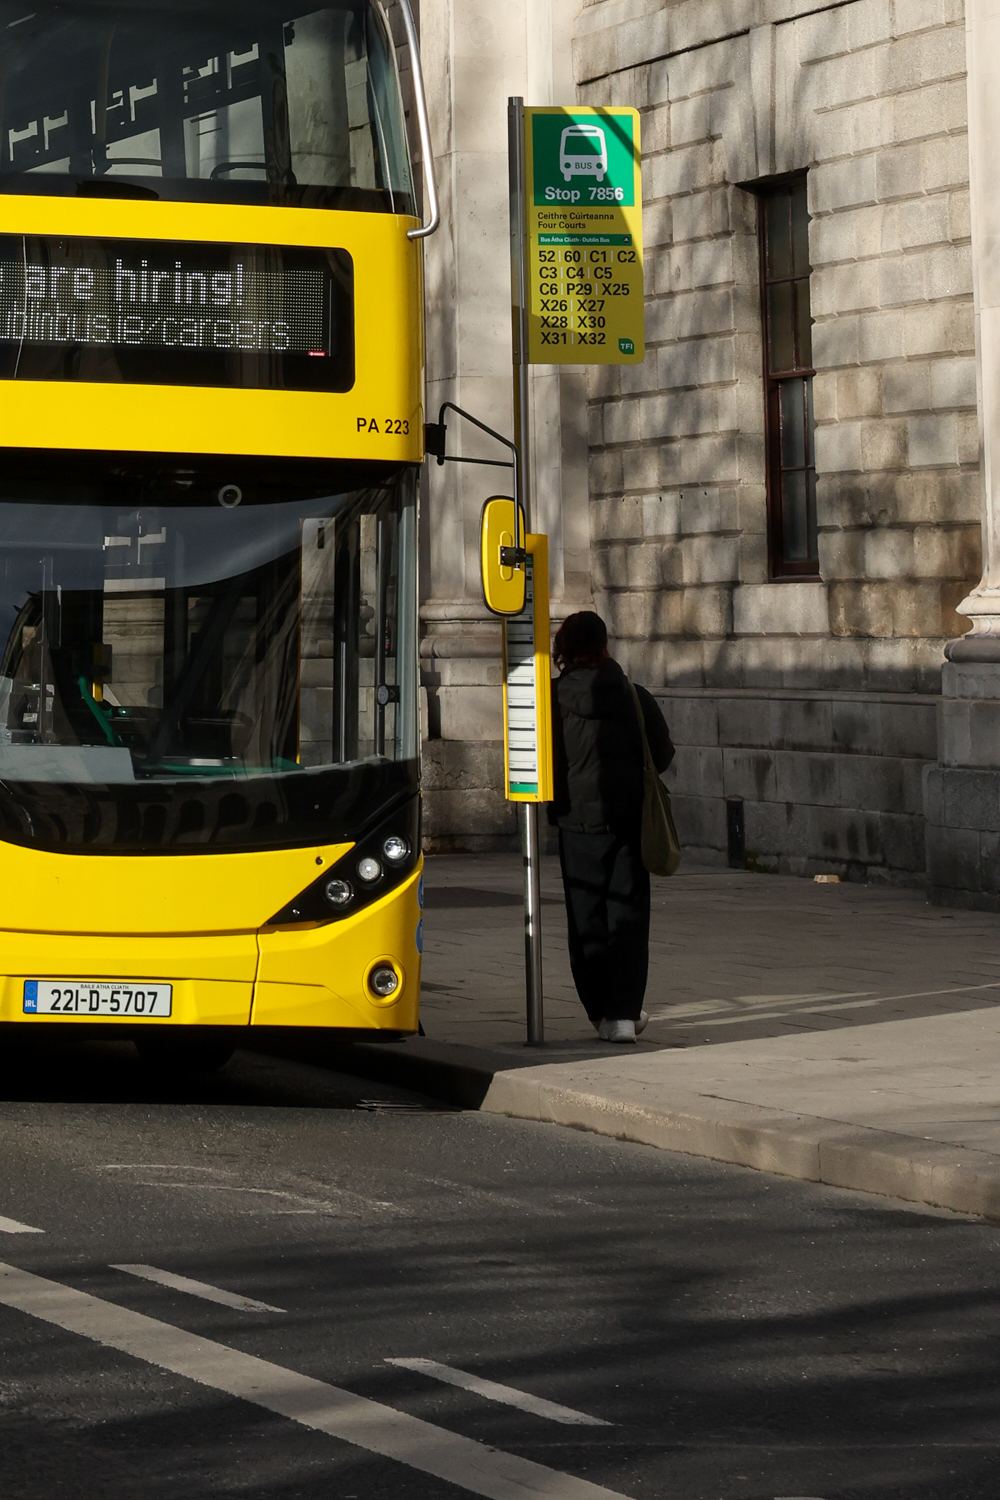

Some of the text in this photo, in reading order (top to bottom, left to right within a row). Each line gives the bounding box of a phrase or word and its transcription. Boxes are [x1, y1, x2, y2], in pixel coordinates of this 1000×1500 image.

[574, 162, 593, 170] BUS
[544, 186, 624, 203] Stop 7856
[537, 211, 615, 220] Ceithre Cúirteanna
[537, 220, 587, 229] Four Courts
[538, 250, 636, 263] 52 60 C1 C2
[539, 266, 613, 279] C3 C4 C5
[25, 264, 94, 299] are
[115, 258, 244, 306] hiring!
[539, 283, 630, 295] C6 P29 X25
[540, 299, 605, 312] X26 X27
[540, 315, 606, 328] X28 X30
[540, 332, 606, 345] X31 X32
[356, 417, 410, 436] PA 223
[24, 999, 37, 1008] IRL
[50, 988, 158, 1013] 221-D-5707
